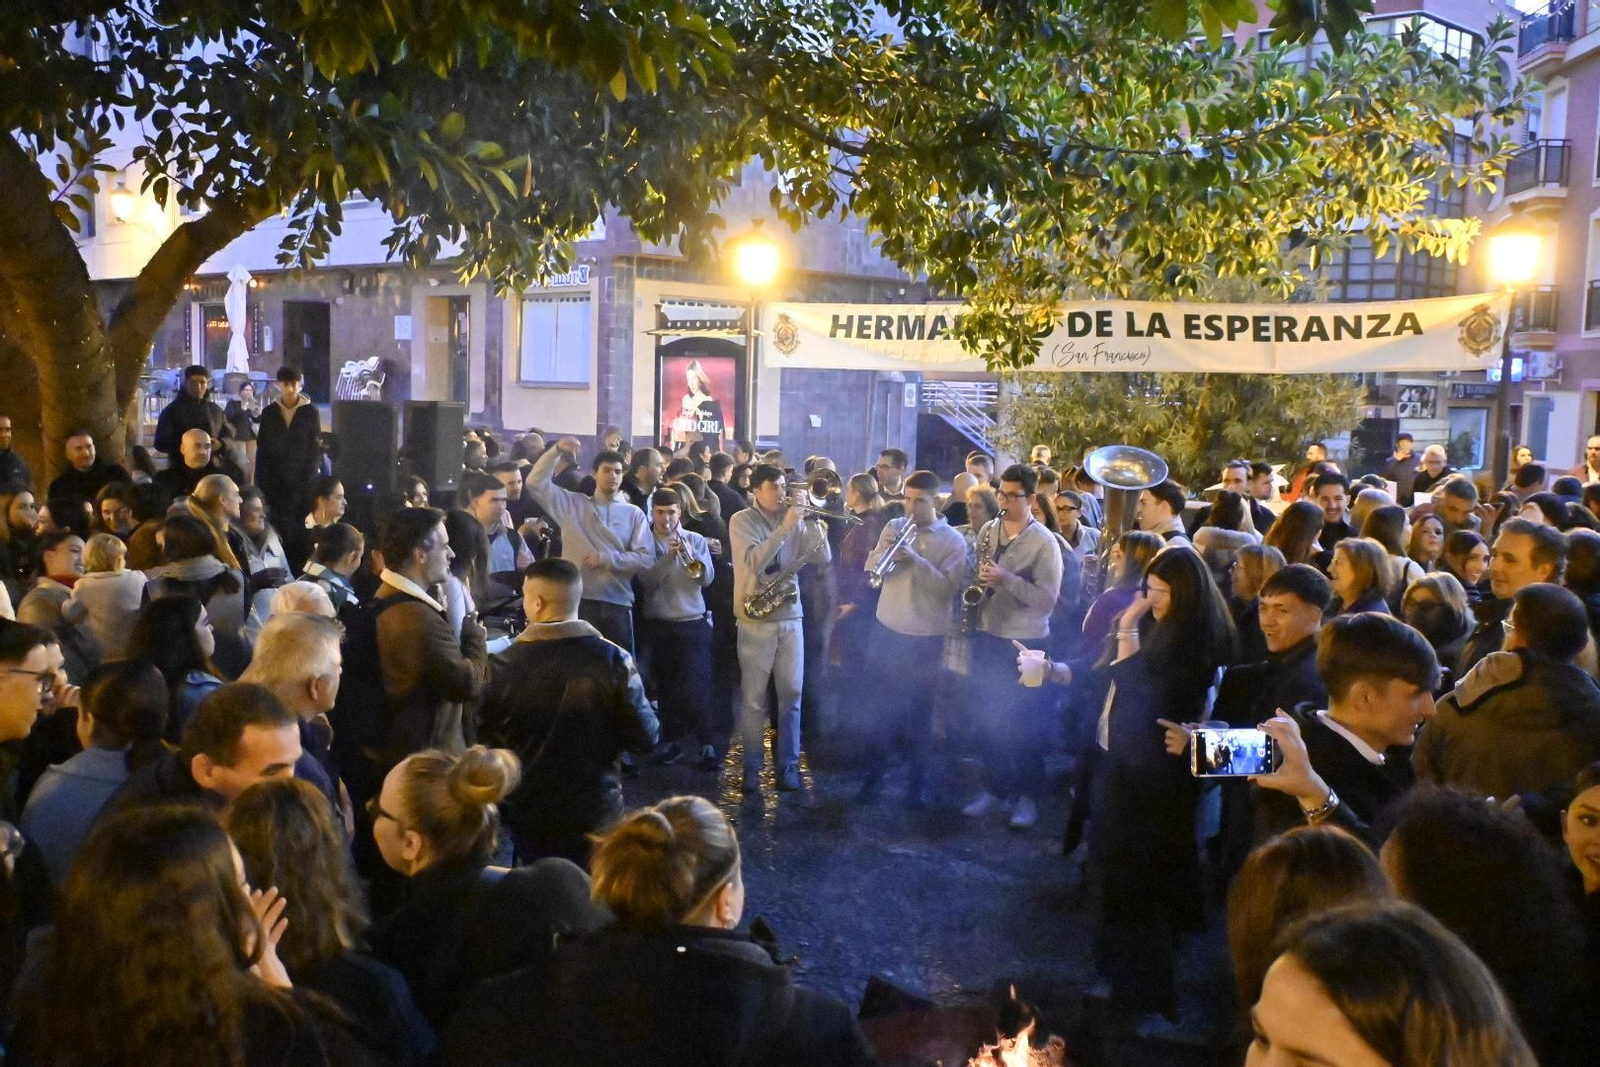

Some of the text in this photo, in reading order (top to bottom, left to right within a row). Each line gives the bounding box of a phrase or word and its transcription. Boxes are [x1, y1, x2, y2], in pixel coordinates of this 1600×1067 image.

[1067, 310, 1113, 338] DE
[1126, 311, 1171, 339] LA
[1183, 311, 1424, 343] ESPERANZA
[697, 420, 722, 434] GIRL
